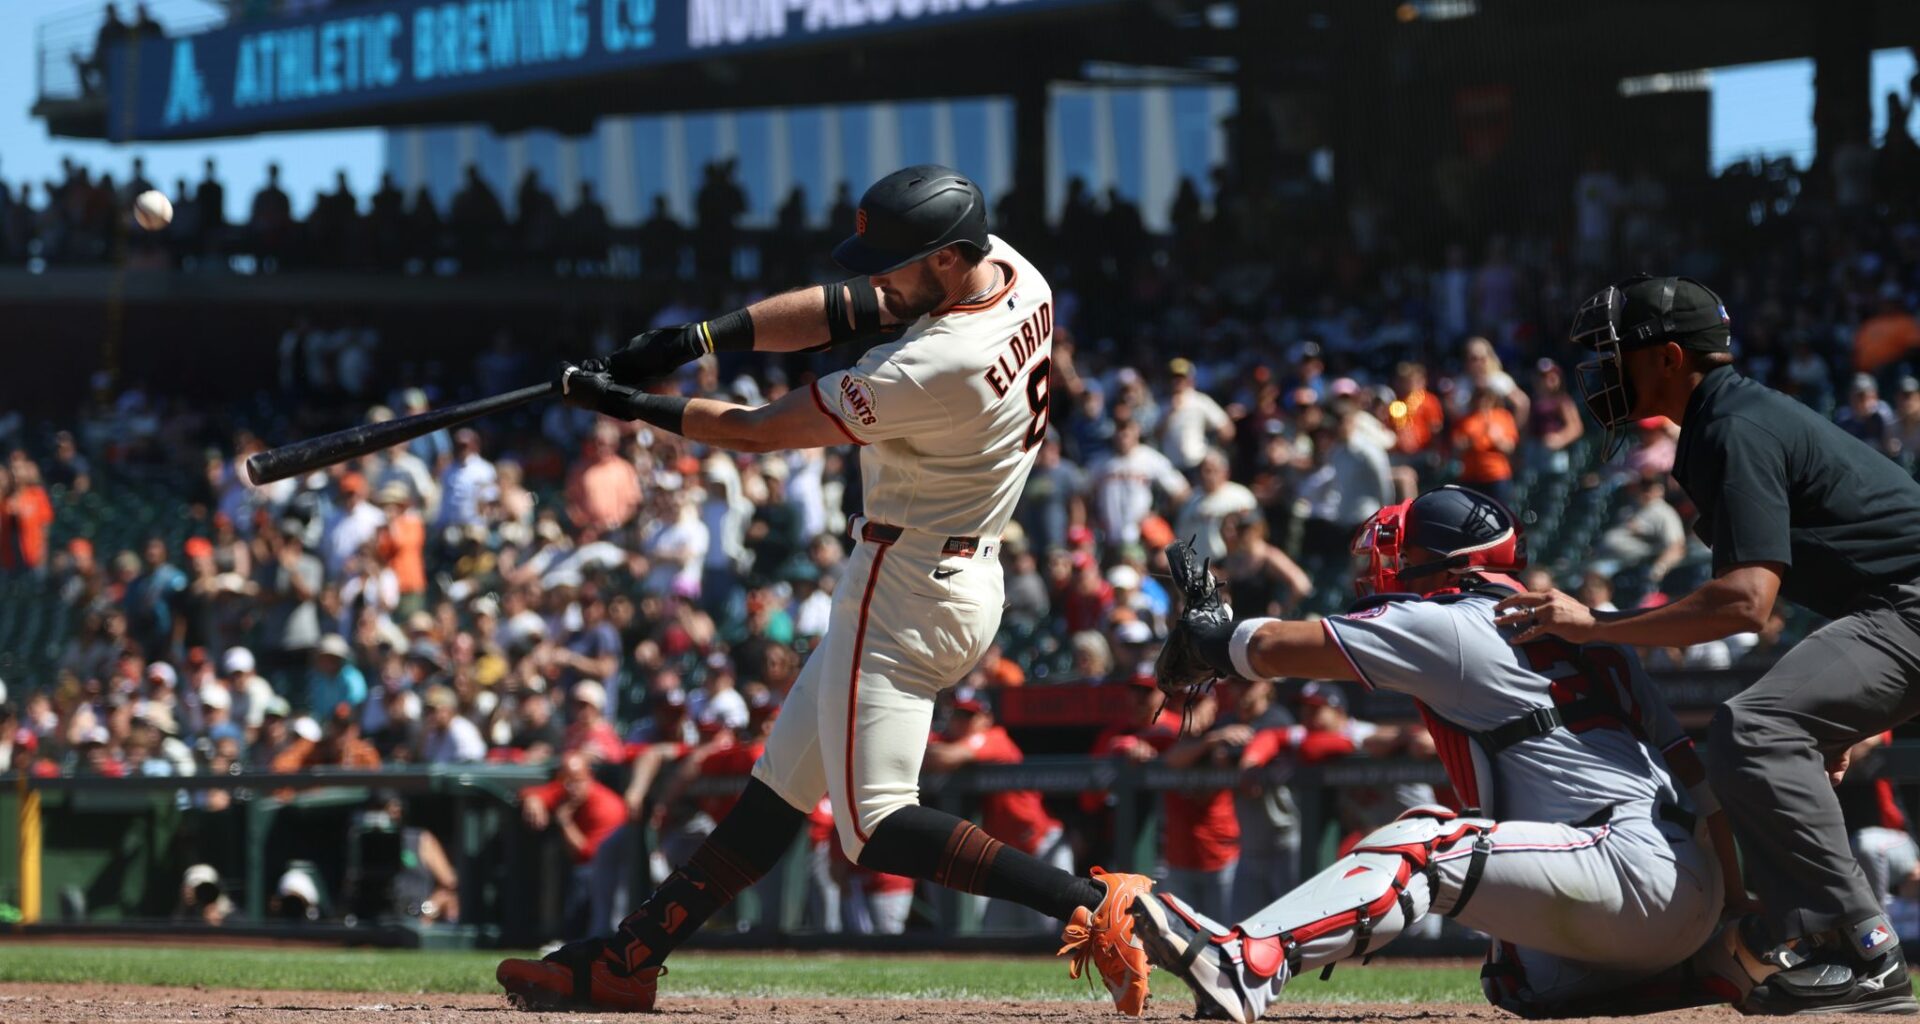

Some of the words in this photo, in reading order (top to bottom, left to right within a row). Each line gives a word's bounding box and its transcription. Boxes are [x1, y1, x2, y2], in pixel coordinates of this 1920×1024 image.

[233, 13, 402, 108] ATHLETIC
[413, 0, 590, 81] BREWING
[840, 374, 877, 426] GIANTS
[983, 301, 1052, 400] ELDRID
